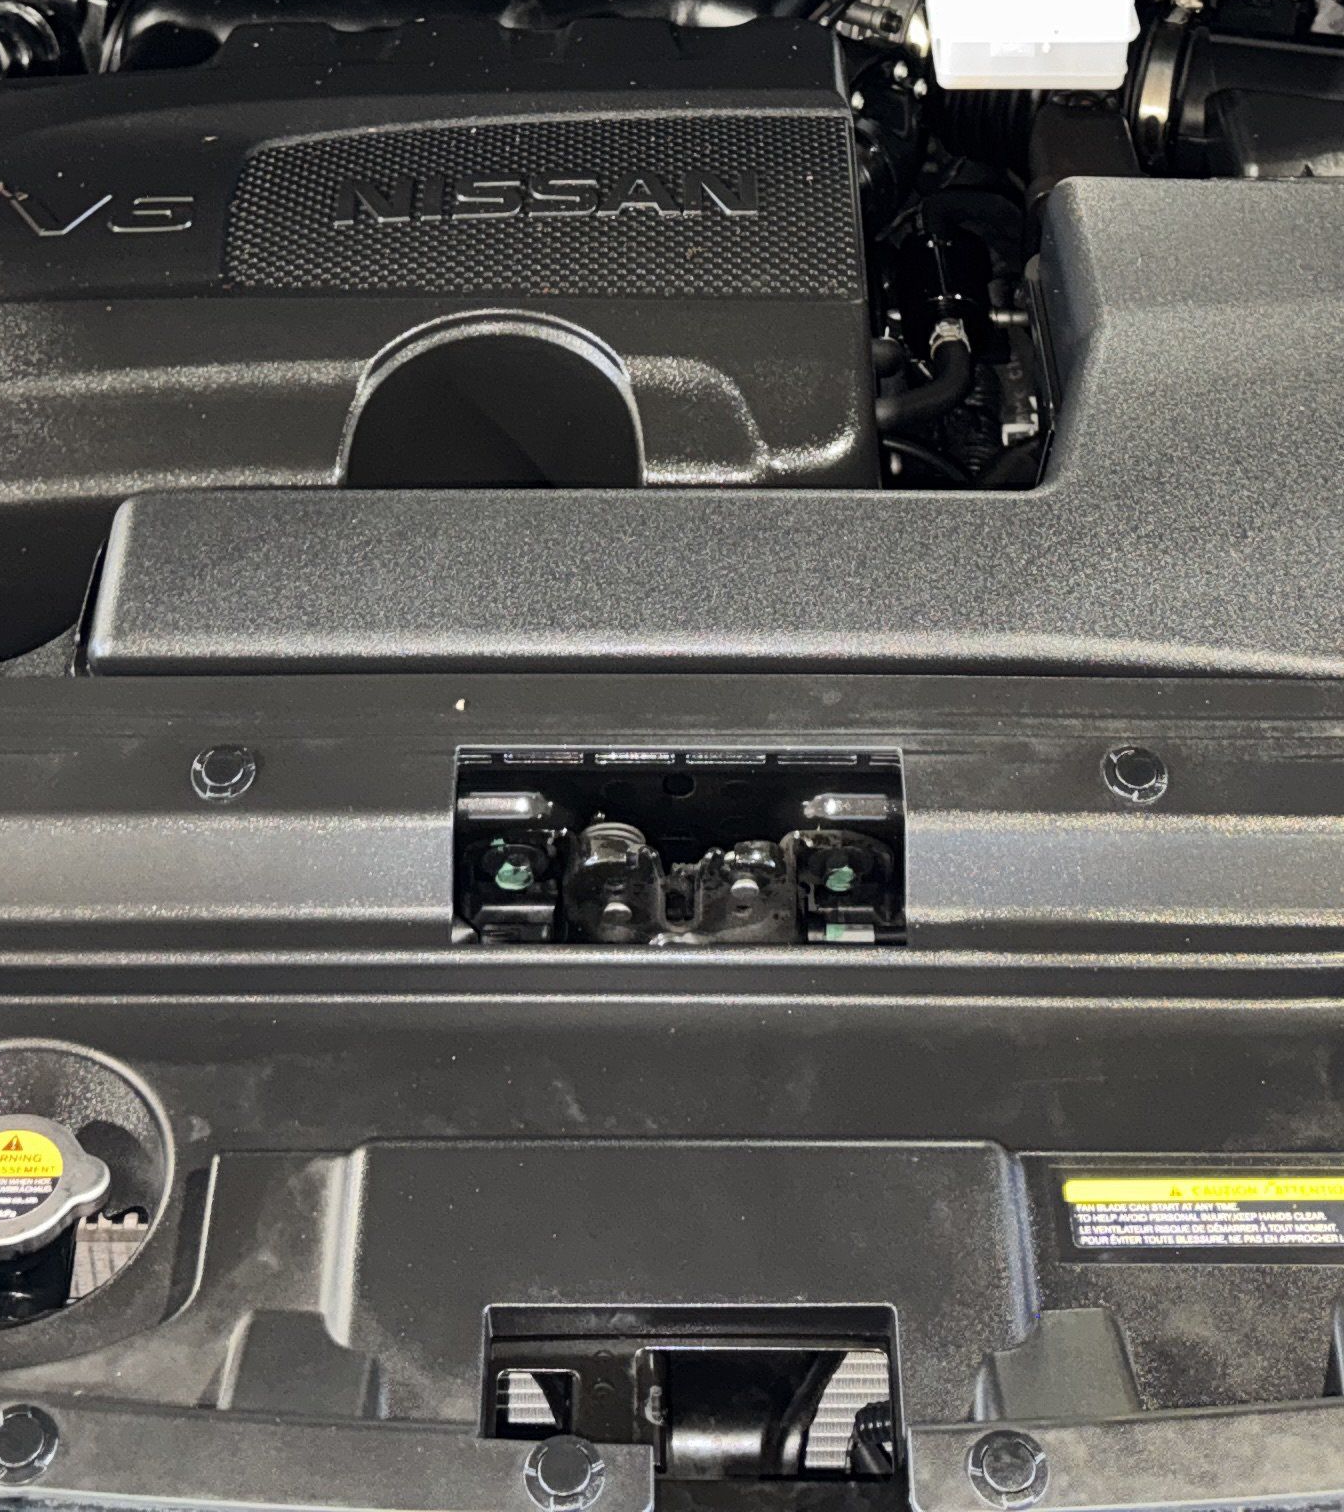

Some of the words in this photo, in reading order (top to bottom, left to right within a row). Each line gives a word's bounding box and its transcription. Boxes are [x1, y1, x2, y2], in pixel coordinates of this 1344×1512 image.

[332, 171, 758, 228] NISSAN
[1191, 1184, 1258, 1196] CAUTION
[1075, 1203, 1095, 1212] FAN
[1096, 1203, 1127, 1212] BLADE
[1128, 1203, 1150, 1212] CAN
[1151, 1203, 1180, 1211] START
[1181, 1203, 1194, 1211] AT
[1195, 1203, 1214, 1211] ANY
[1078, 1214, 1092, 1222] TO
[1093, 1214, 1117, 1222] HELP
[1118, 1213, 1148, 1222] AVOID
[1149, 1213, 1200, 1221] PERSONAL
[1258, 1212, 1292, 1221] HANDS
[1293, 1212, 1328, 1221] CLEAR.
[1079, 1226, 1091, 1234] LE
[1092, 1225, 1153, 1234] VENTILATEUR
[1154, 1224, 1190, 1234] RISQUE
[1192, 1225, 1205, 1233] DE
[1208, 1222, 1259, 1233] DÉMARRER
[1268, 1224, 1294, 1232] TOUT
[1295, 1223, 1339, 1232] MOMENT.
[1081, 1236, 1109, 1245] POUR
[1110, 1234, 1143, 1245] ÉVITER
[1144, 1236, 1175, 1244] TOUTE
[1229, 1235, 1242, 1244] NE
[1243, 1235, 1263, 1244] PAS
[1264, 1235, 1278, 1243] EN
[1279, 1234, 1338, 1243] APPROCHER
